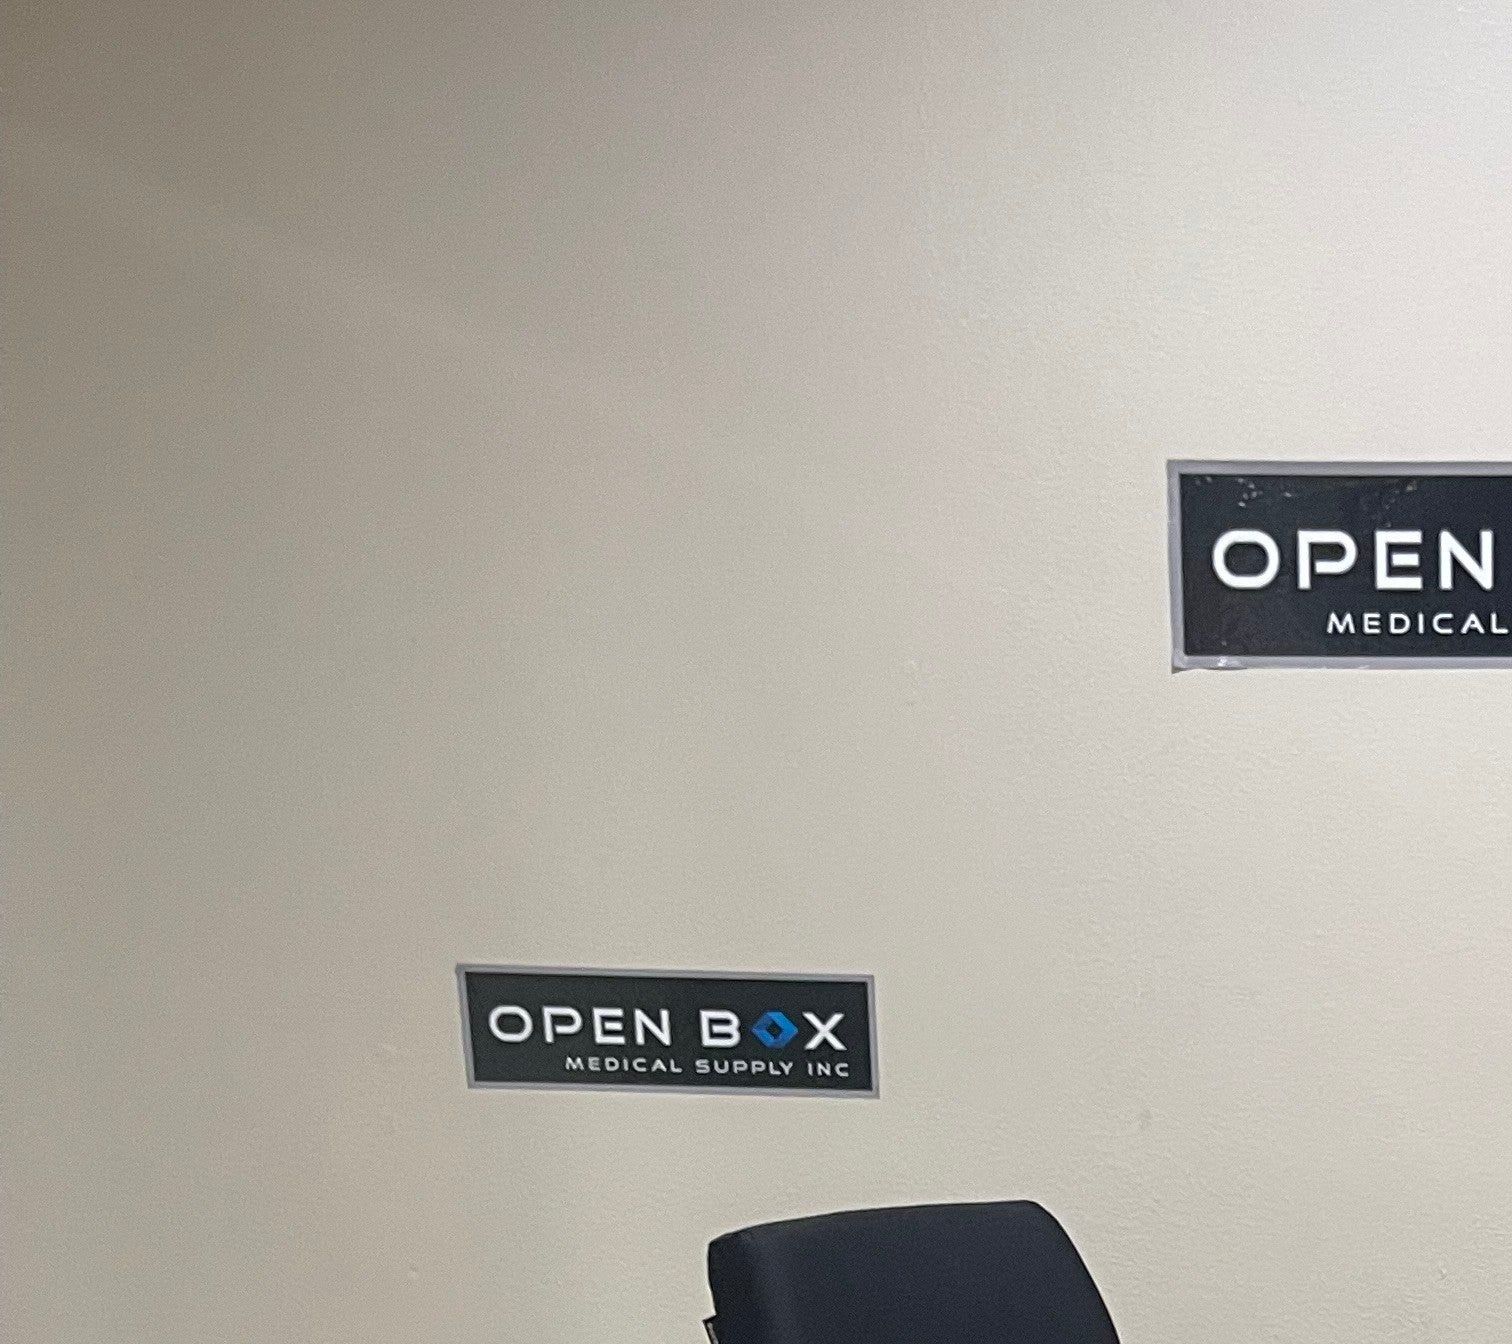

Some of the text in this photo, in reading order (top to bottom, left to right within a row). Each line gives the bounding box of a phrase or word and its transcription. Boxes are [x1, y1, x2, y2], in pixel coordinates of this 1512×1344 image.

[1212, 529, 1494, 590] OPEN
[1326, 611, 1508, 634] MEDICAL
[488, 1005, 671, 1046] OPEN
[565, 1056, 849, 1077] MEDICAL SUPPLY INC
